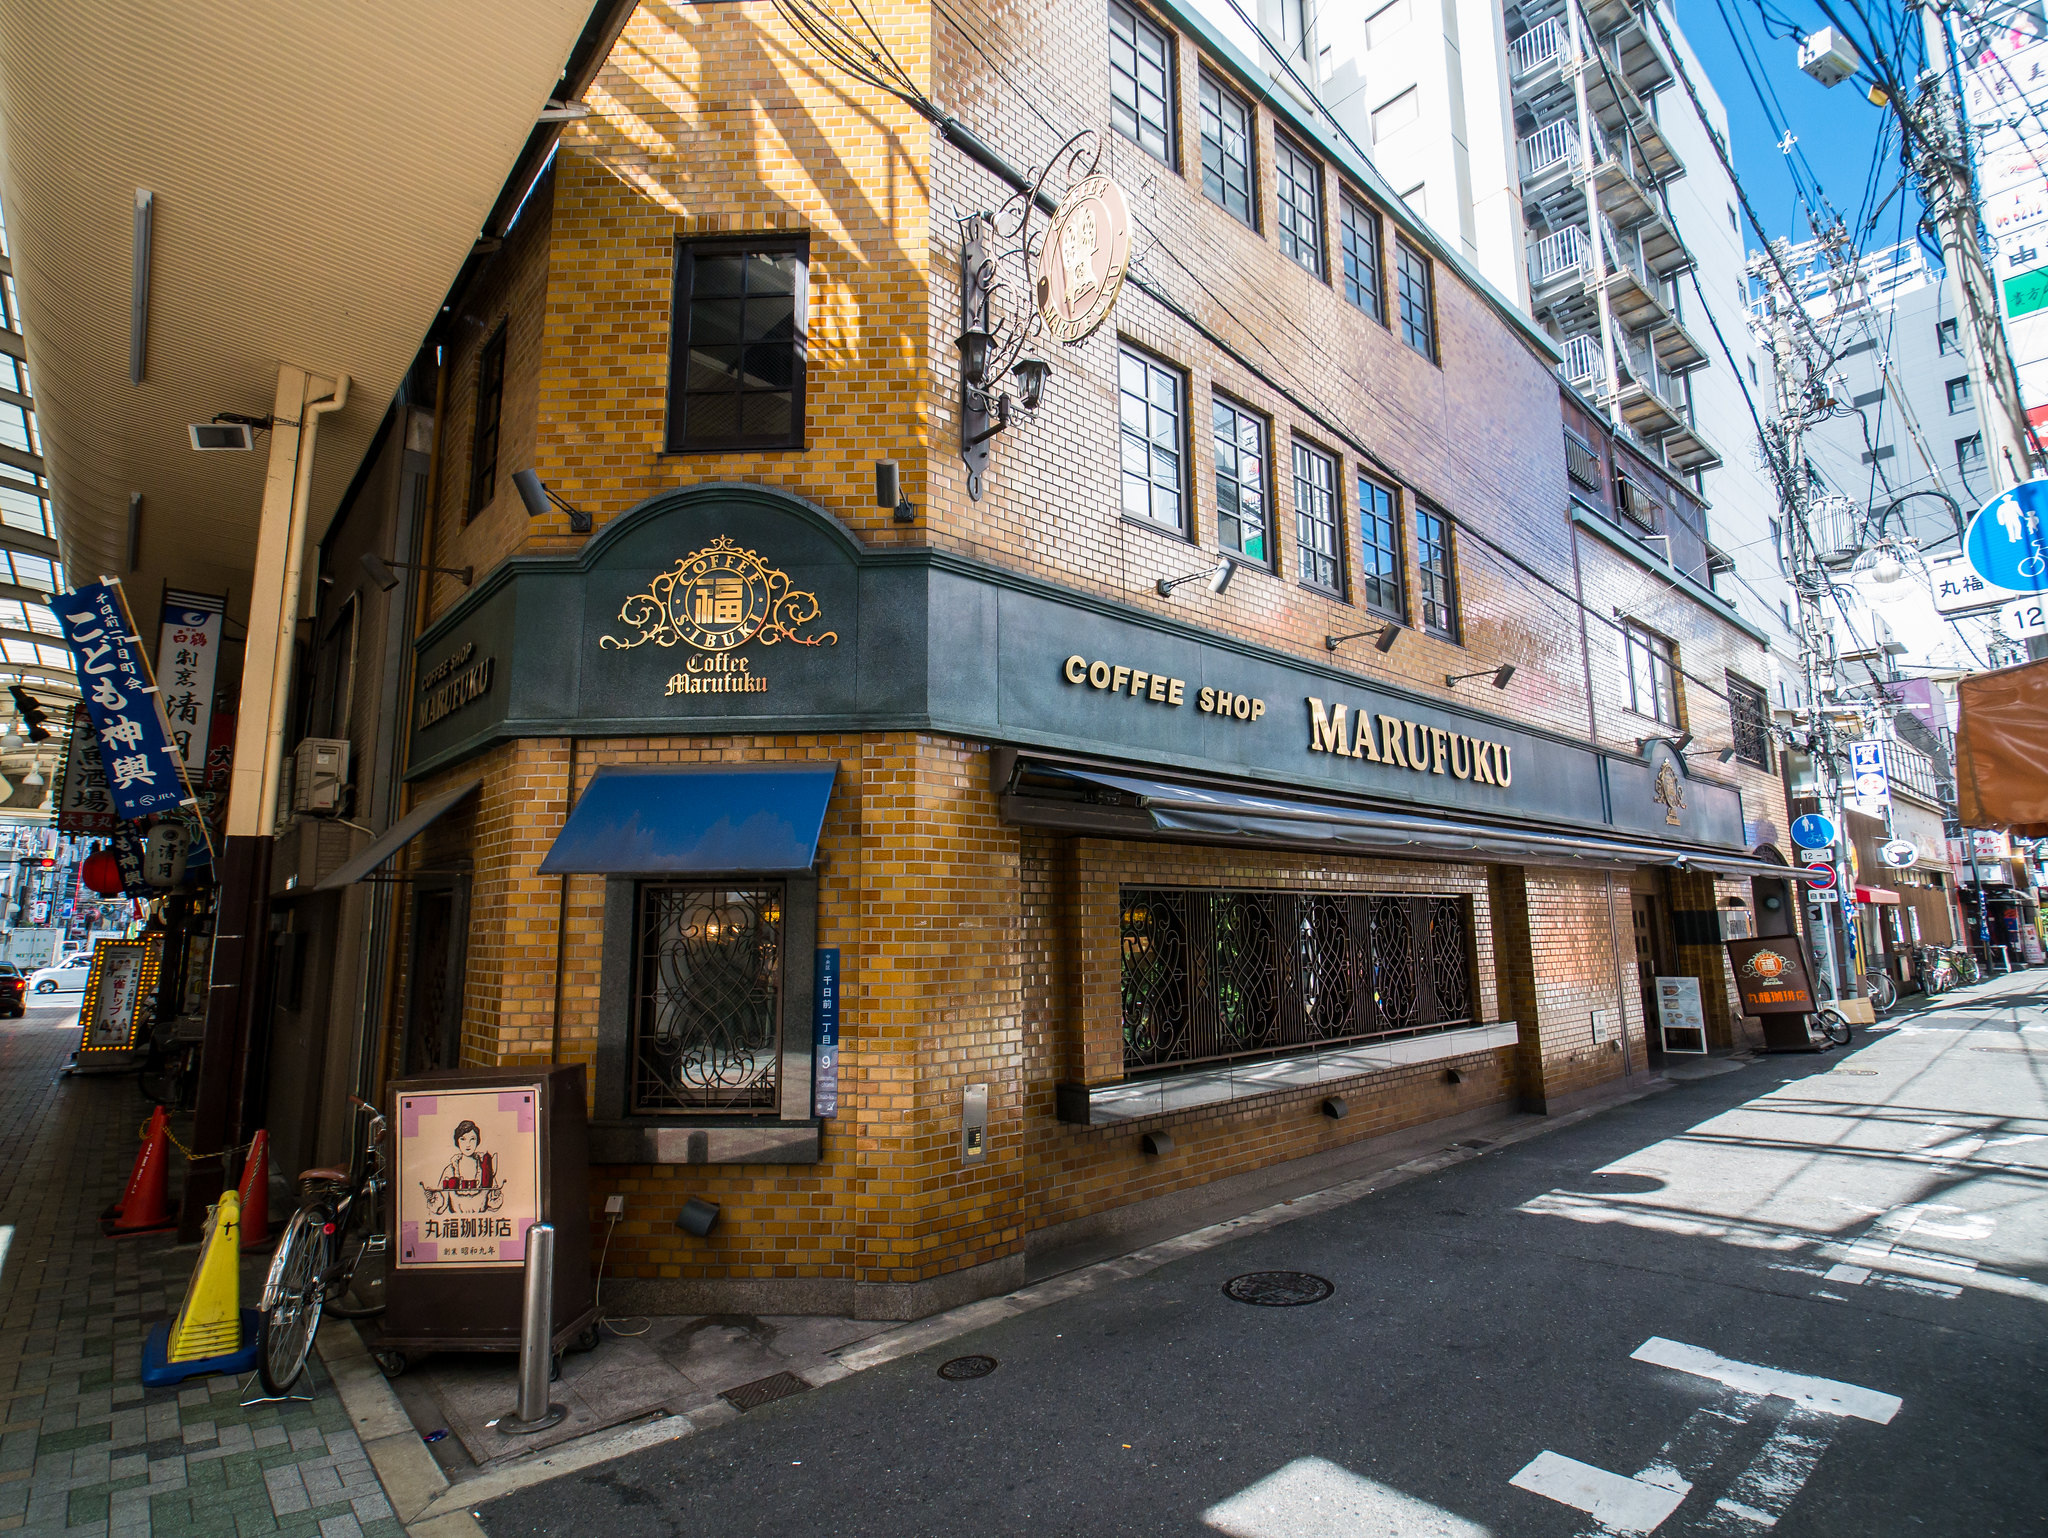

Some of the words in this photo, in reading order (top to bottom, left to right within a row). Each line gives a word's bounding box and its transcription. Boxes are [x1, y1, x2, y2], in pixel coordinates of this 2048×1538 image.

[679, 554, 763, 586] COFFEE
[696, 578, 743, 624] 福
[172, 629, 208, 647] 白鶴
[686, 652, 749, 674] Coffee
[418, 656, 490, 731] MARUFUKU
[664, 672, 768, 697] Marufuku
[1065, 654, 1186, 706] COFFEE
[1199, 686, 1266, 721] SHOP
[66, 611, 157, 790] こども神輿
[1306, 696, 1513, 788] MARUFUKU
[156, 792, 176, 801] JRA
[1974, 836, 2001, 844] ダルト
[1747, 990, 1809, 1004] 丸福珈琲店
[822, 975, 832, 1045] 千日前一丁目
[821, 1055, 831, 1069] 9
[425, 1217, 512, 1239] 丸福珈琲店
